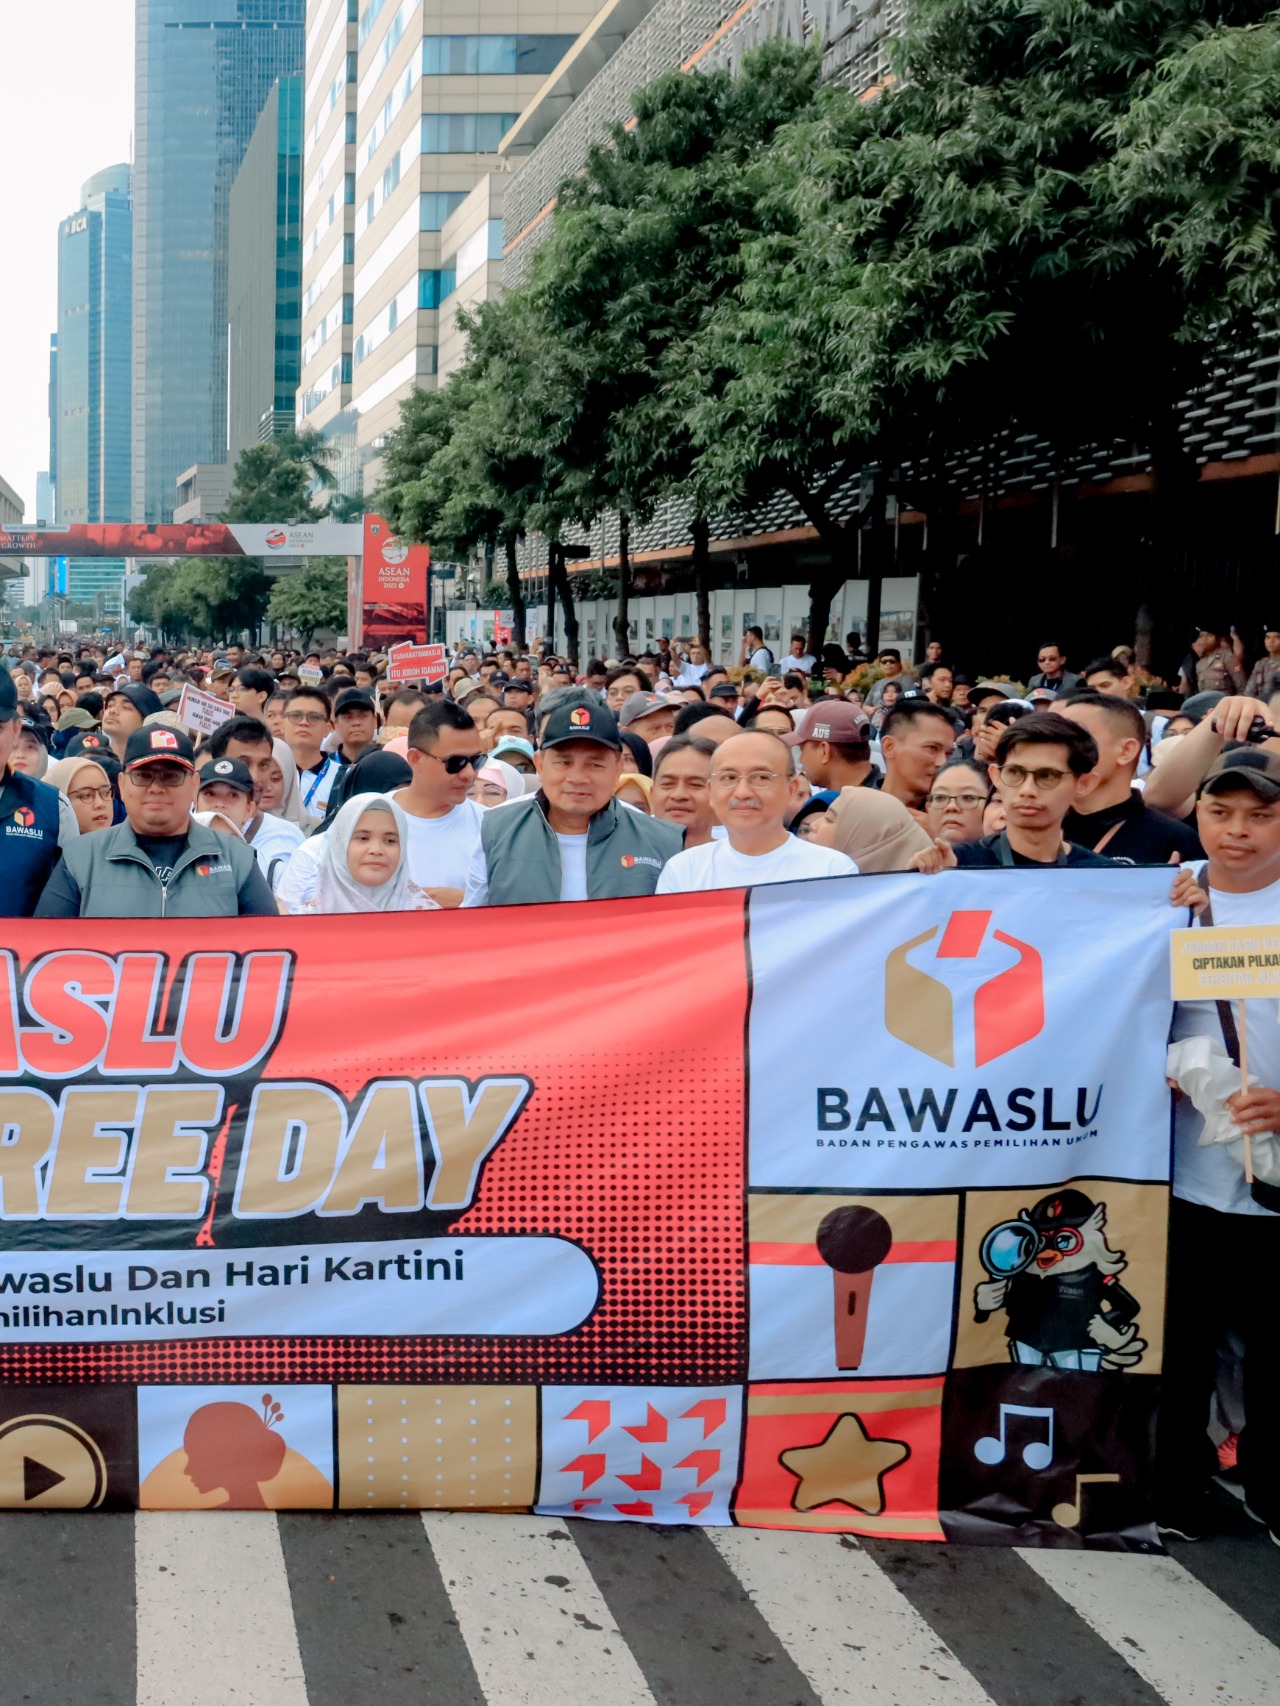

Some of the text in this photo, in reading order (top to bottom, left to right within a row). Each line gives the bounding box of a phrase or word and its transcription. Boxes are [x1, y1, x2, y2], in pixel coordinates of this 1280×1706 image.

[71, 217, 87, 234] BCA
[378, 567, 410, 576] ASEAN
[391, 665, 445, 678] ITU JODOH IDAMAN
[812, 727, 830, 739] AUS
[6, 825, 43, 837] BAWASLU
[1192, 954, 1280, 970] CIPTAKAN PILKA
[817, 1084, 1104, 1133] BAWASLU
[231, 1078, 531, 1219] DAY
[816, 1139, 870, 1147] BADAN
[877, 1139, 968, 1149] PENGAWAS
[974, 1138, 1061, 1147] PEMILIHAN
[128, 1264, 211, 1292] Dan
[225, 1255, 310, 1287] Hari
[324, 1249, 464, 1283] Kartini
